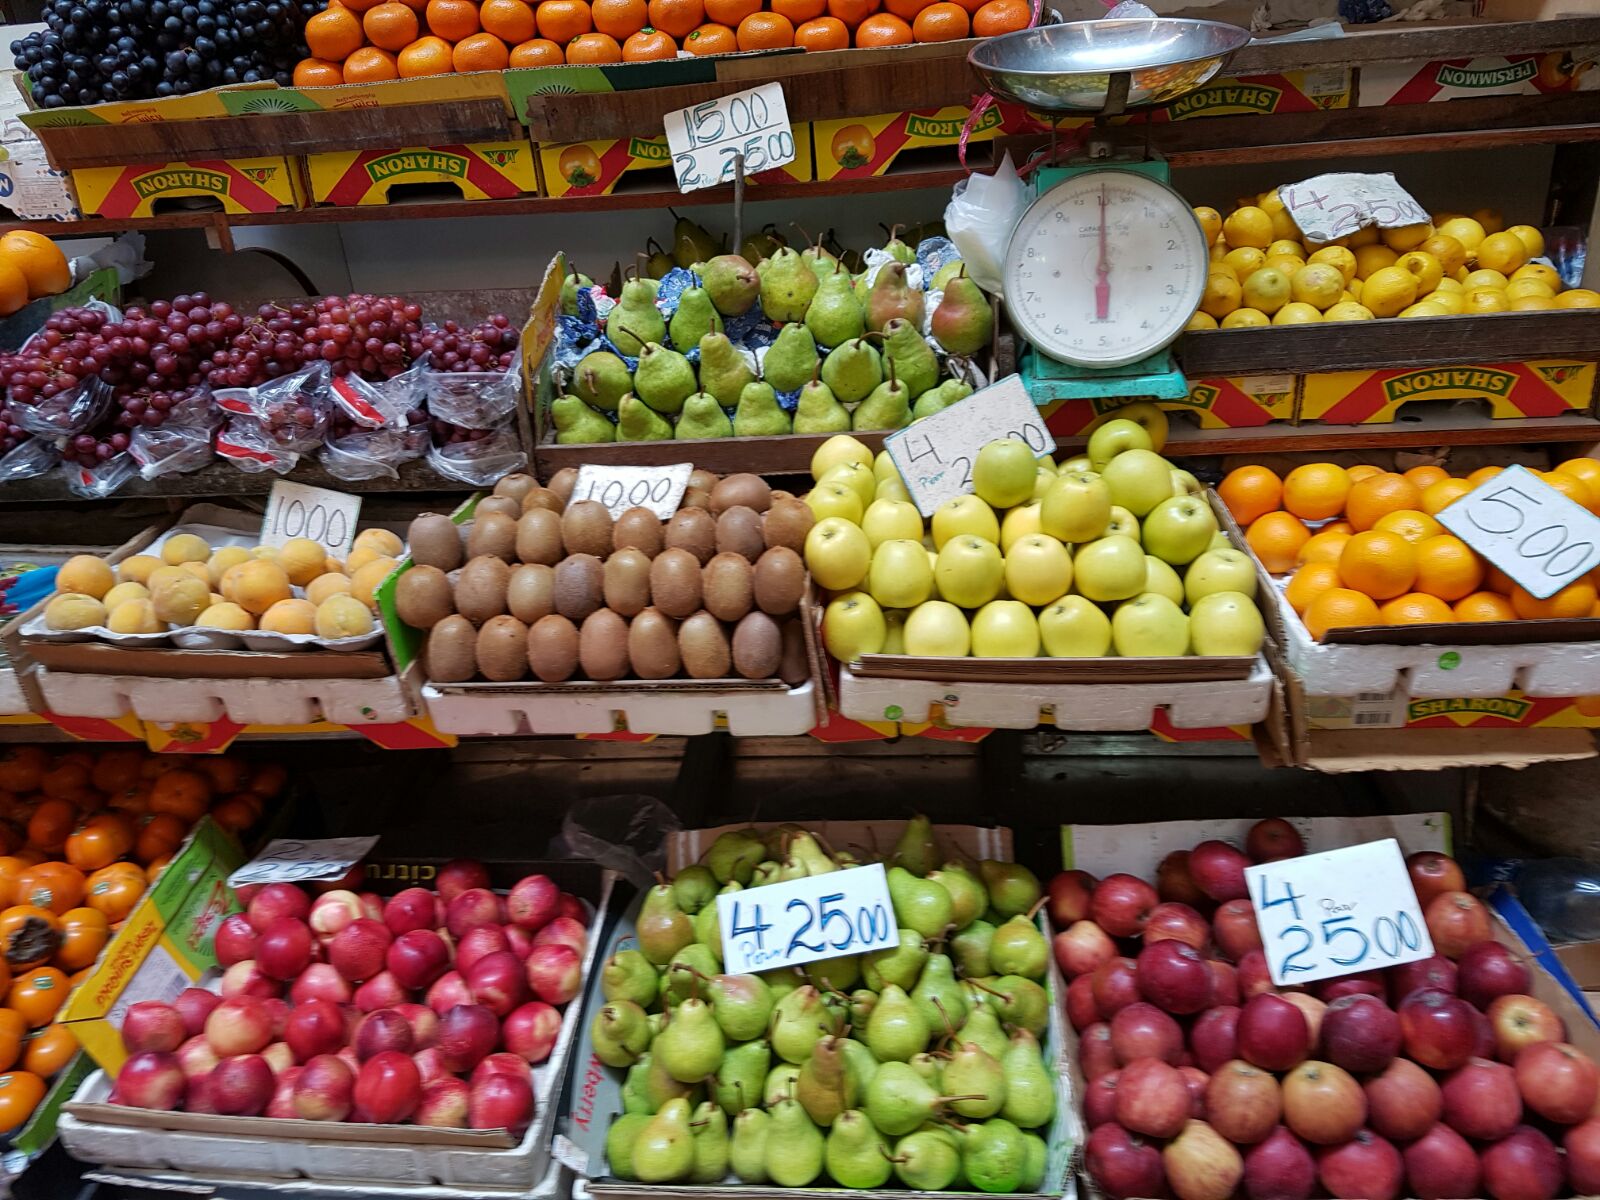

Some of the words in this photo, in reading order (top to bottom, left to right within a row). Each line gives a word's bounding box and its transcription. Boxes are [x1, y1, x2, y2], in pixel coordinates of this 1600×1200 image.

[1442, 63, 1531, 85] PERSIMMON
[1175, 88, 1273, 114] SHARON
[375, 155, 461, 177] SHARON
[676, 154, 700, 187] 2
[141, 172, 223, 194] SHARON
[1289, 189, 1329, 210] 4
[1394, 371, 1507, 396] SHARON
[904, 434, 943, 464] 4
[273, 496, 347, 547] 1000
[1465, 486, 1595, 577] 5.00
[1414, 698, 1519, 715] SHARON
[366, 864, 436, 885] citru
[1259, 874, 1306, 920] 4
[731, 901, 773, 950] 4
[570, 1052, 604, 1133] berry
